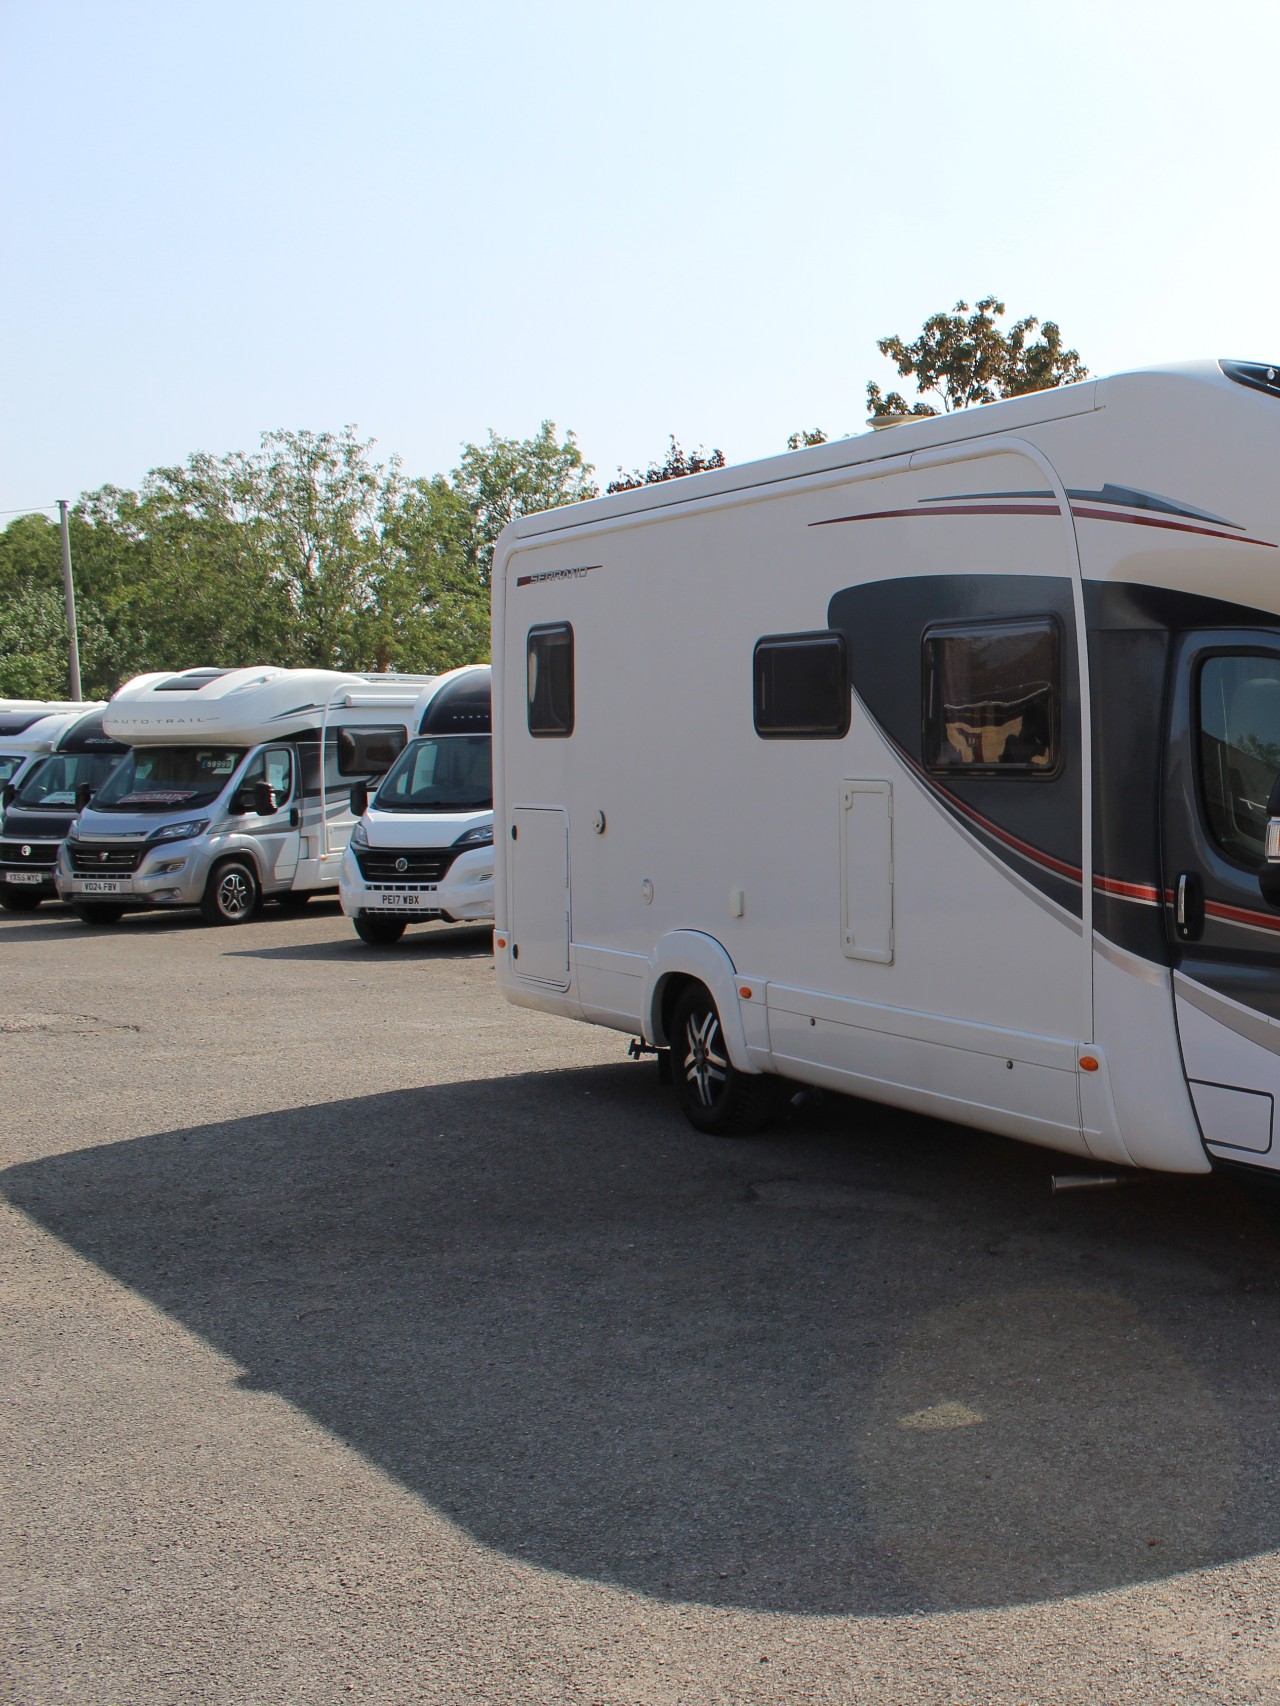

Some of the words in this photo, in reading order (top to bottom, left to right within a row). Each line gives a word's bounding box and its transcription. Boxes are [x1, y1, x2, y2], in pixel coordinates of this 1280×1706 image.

[529, 566, 588, 584] SERRANO
[112, 717, 205, 725] AUTO-TRAIL
[103, 882, 117, 891] FBV
[382, 894, 401, 904] PE17
[402, 895, 420, 905] WBX
